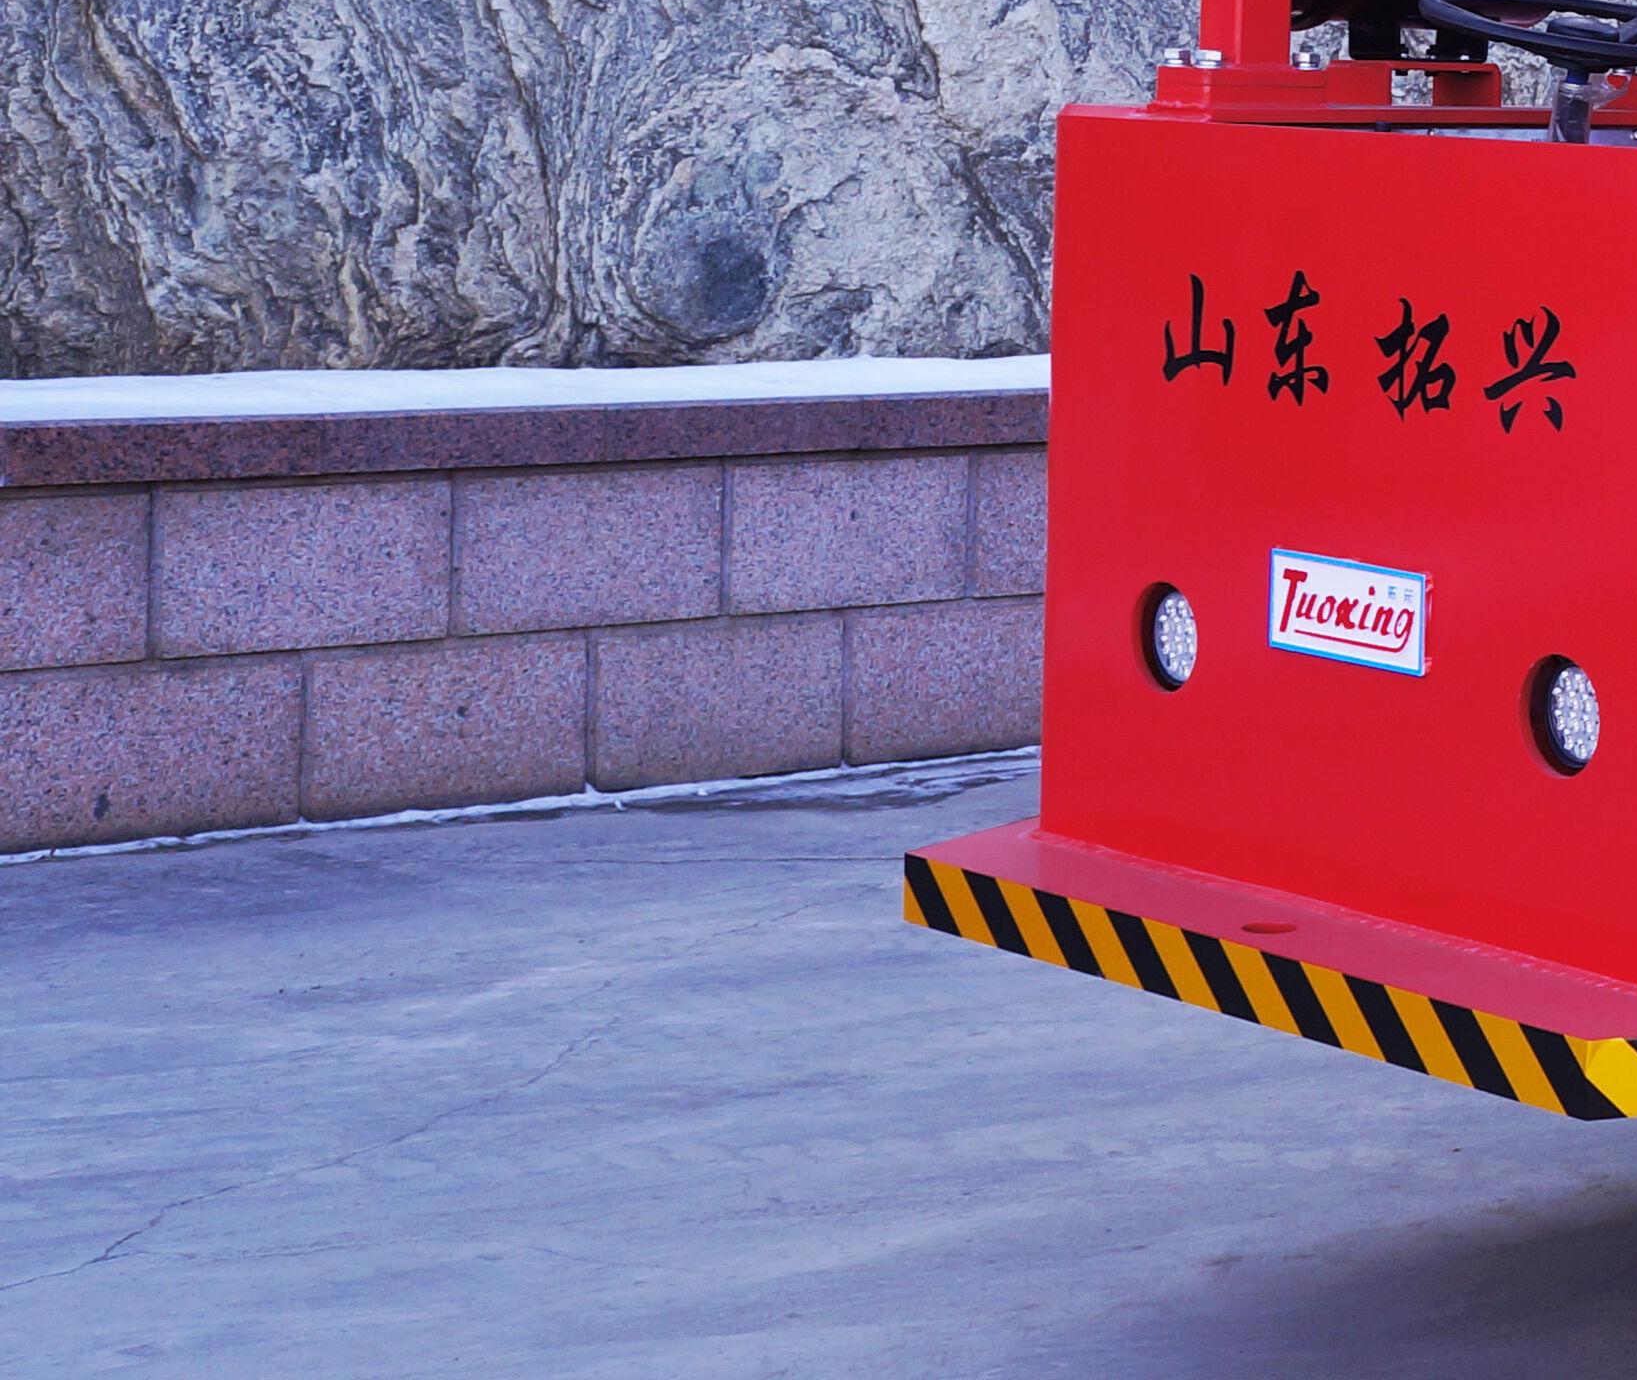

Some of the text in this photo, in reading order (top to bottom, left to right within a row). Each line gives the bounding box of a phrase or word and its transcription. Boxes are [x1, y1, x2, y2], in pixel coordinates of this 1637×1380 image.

[1162, 270, 1577, 434] 山东拓兴
[1279, 568, 1415, 653] Tuoxing
